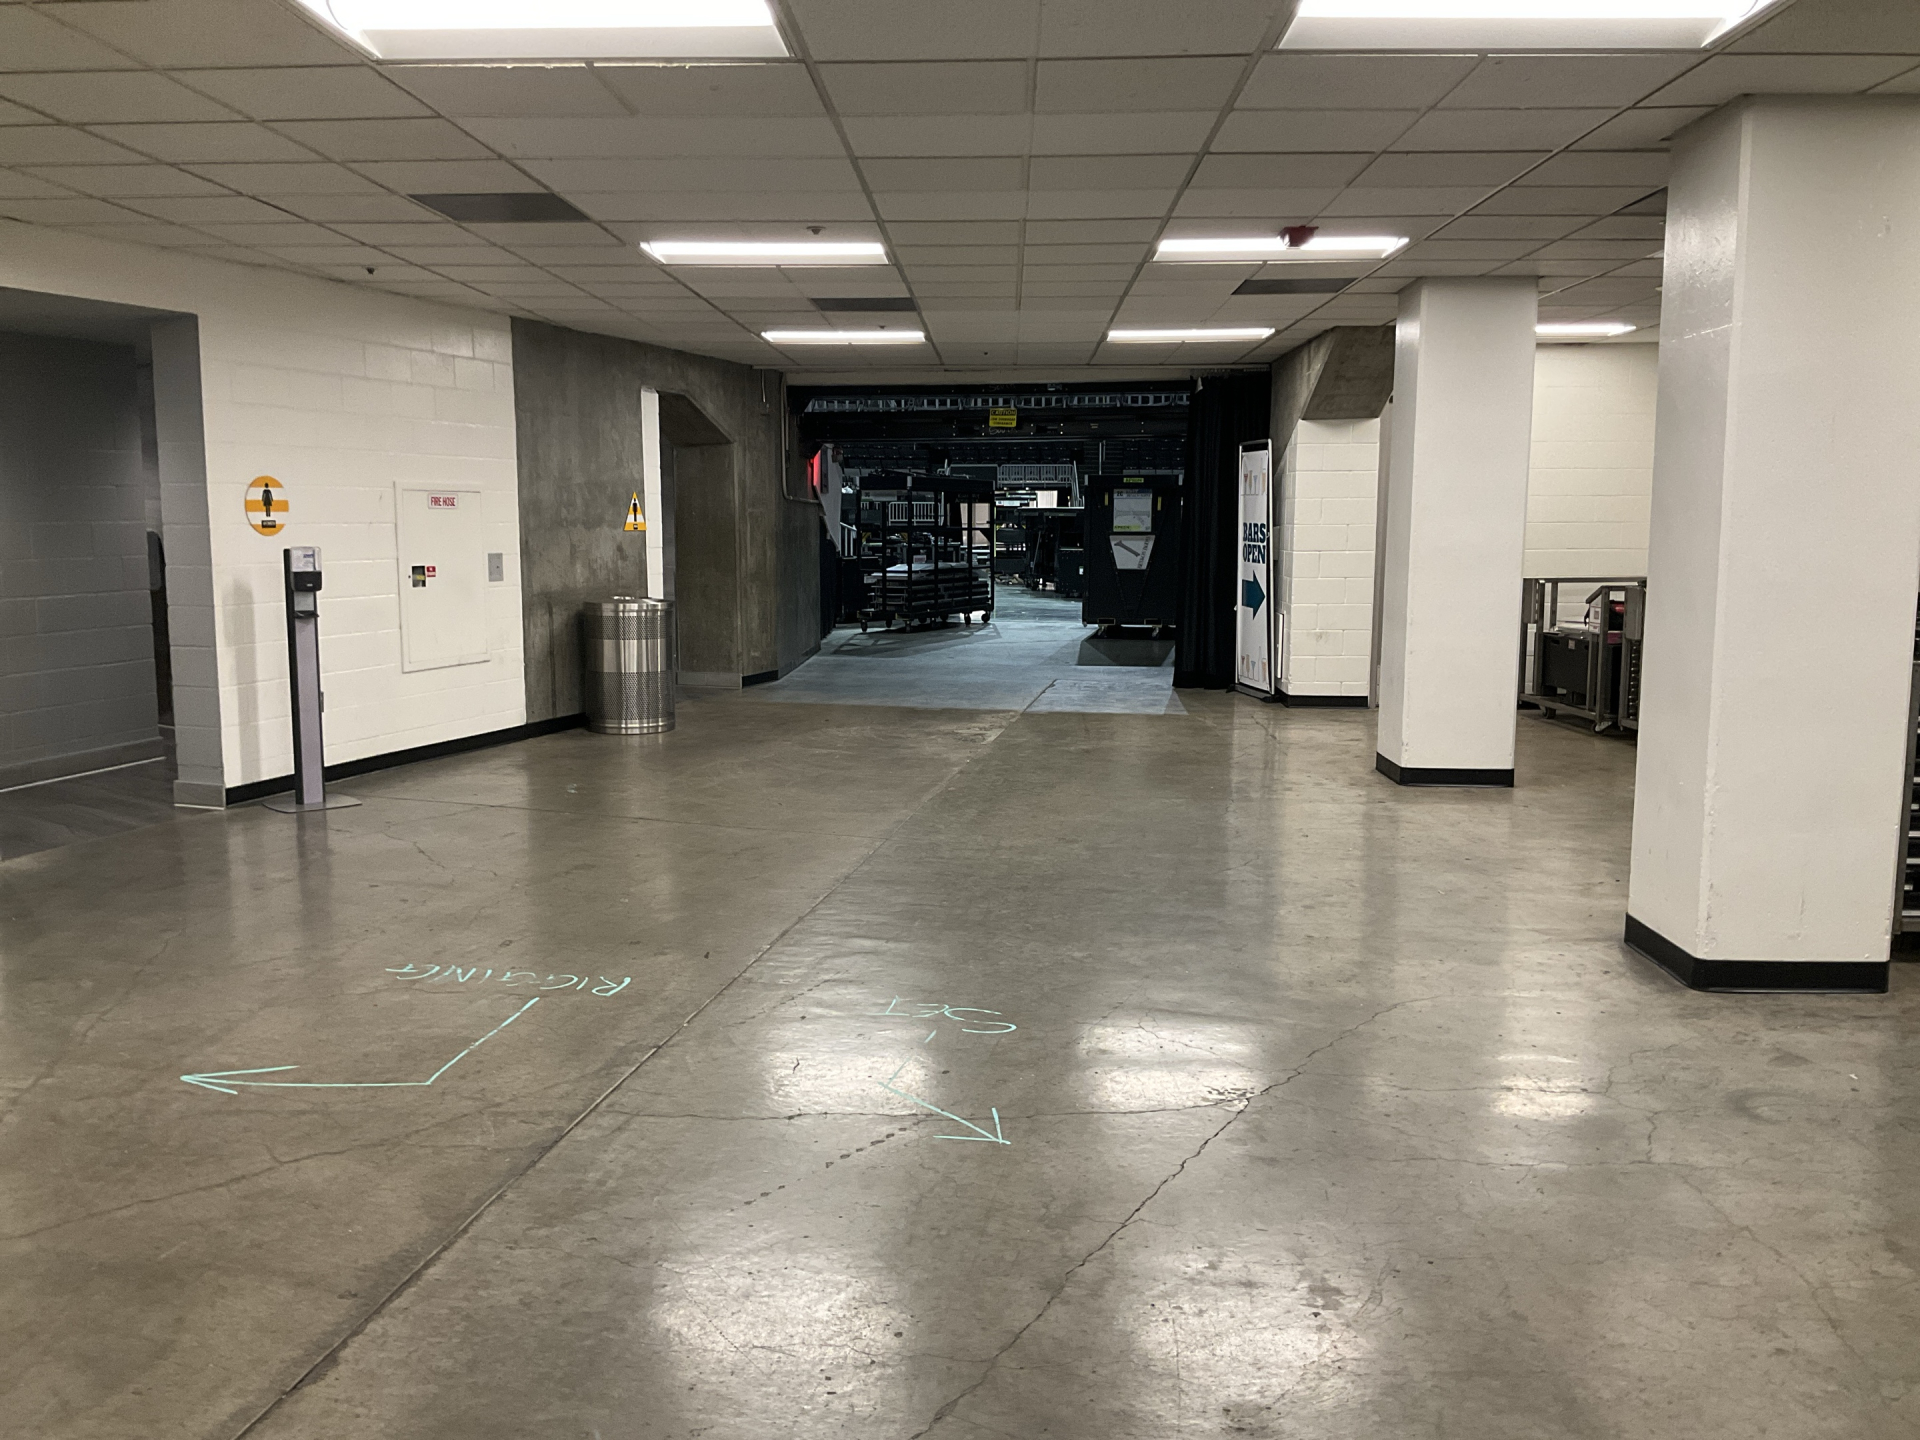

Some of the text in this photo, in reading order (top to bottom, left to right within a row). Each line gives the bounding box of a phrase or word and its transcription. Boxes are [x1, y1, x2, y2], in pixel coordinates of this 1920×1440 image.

[430, 496, 455, 507] FIRE HOSE
[1243, 522, 1266, 543] BARS
[1243, 543, 1266, 564] OPEN
[385, 964, 632, 996] RIGGING
[865, 995, 1017, 1034] SET
